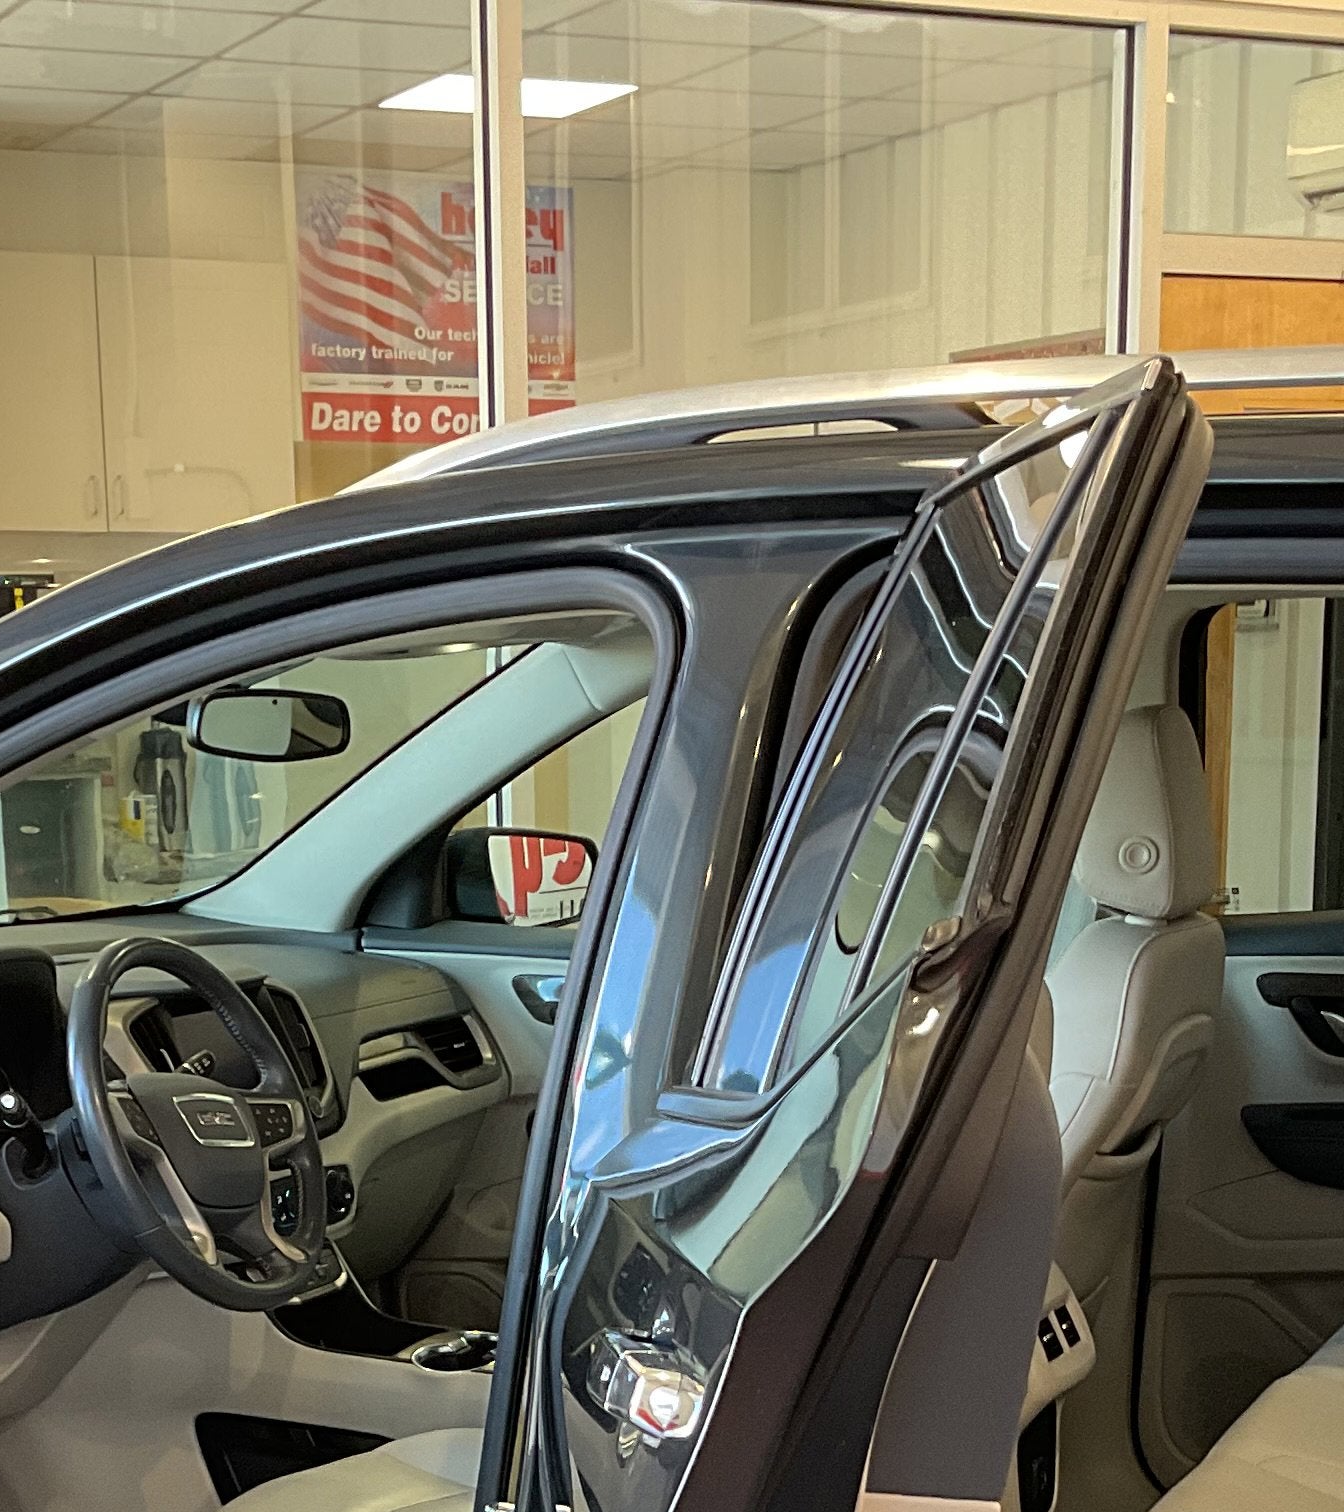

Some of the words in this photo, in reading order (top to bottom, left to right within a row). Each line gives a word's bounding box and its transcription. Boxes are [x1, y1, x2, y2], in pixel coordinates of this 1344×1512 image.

[414, 326, 443, 340] Our
[312, 343, 366, 361] factory
[372, 345, 426, 361] trained
[431, 347, 455, 362] for
[311, 402, 382, 432] Dare
[391, 404, 422, 434] to
